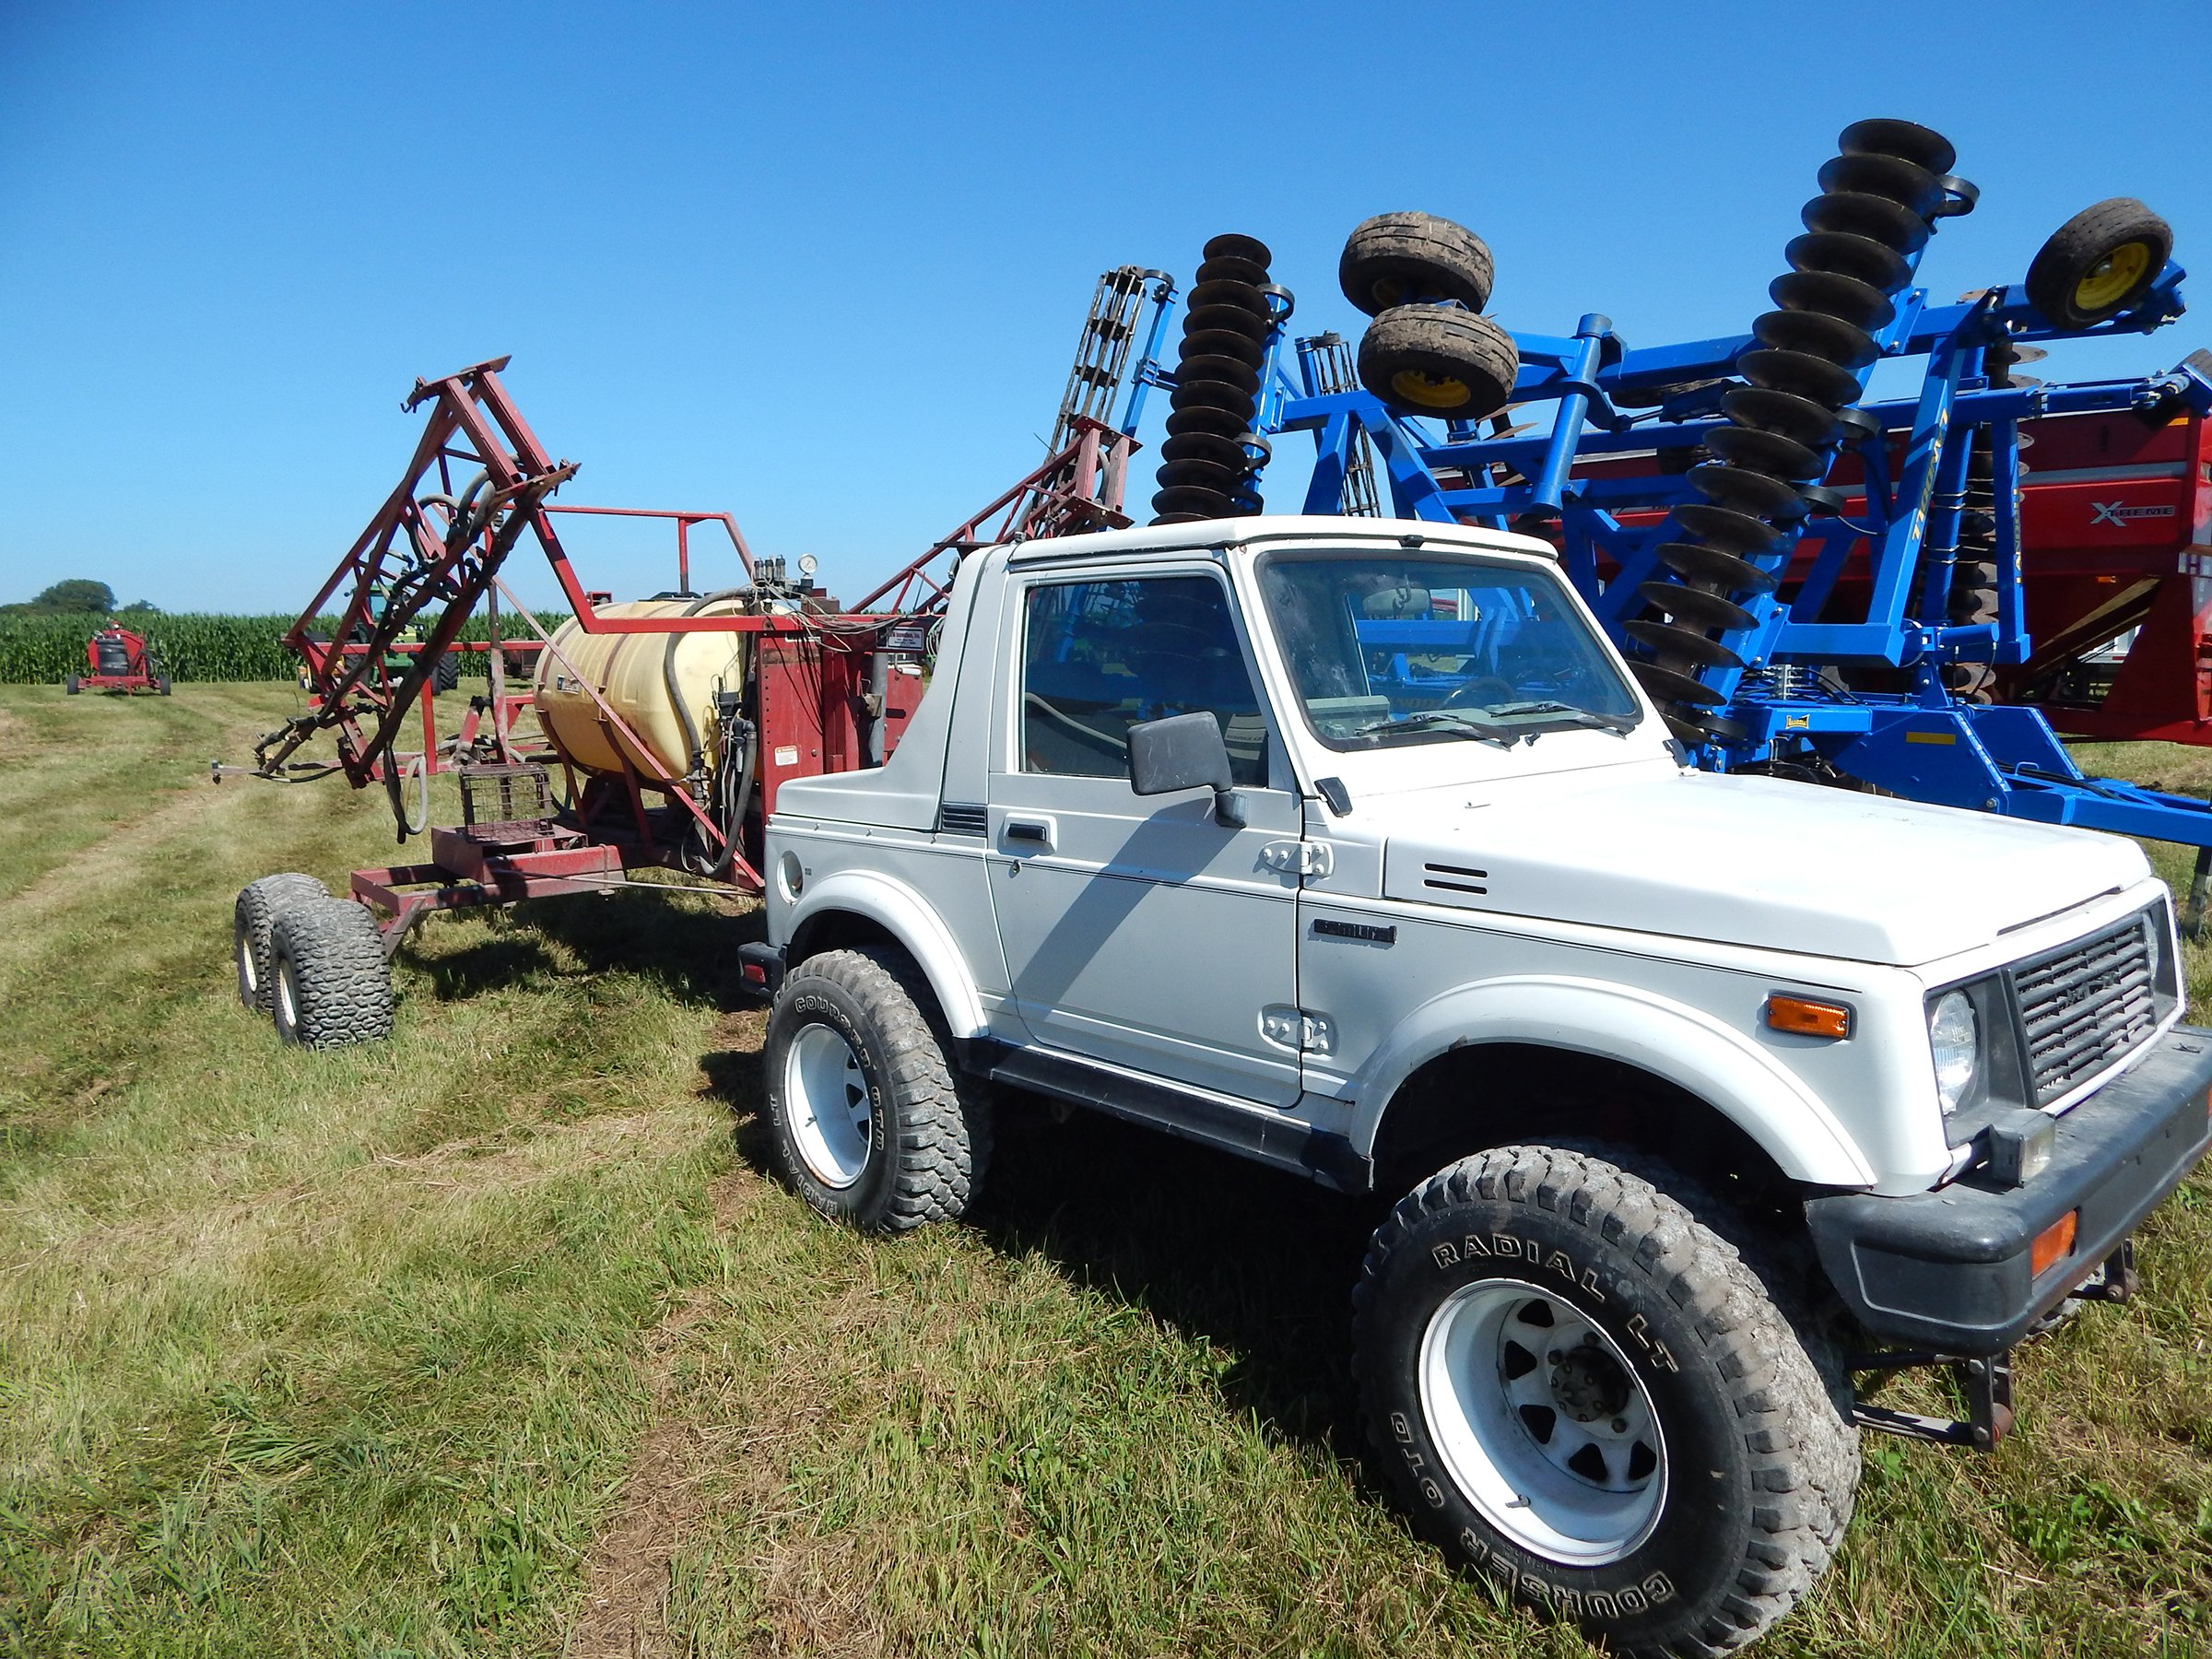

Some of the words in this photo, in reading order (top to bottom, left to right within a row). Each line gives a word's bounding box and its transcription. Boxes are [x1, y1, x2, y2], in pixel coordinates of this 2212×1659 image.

[2089, 500, 2173, 527] XTREME
[1431, 1234, 1606, 1303] RADIAL
[1626, 1312, 1679, 1373] LT
[1390, 1411, 1446, 1509] OTD
[1459, 1526, 1676, 1620] COURSER
